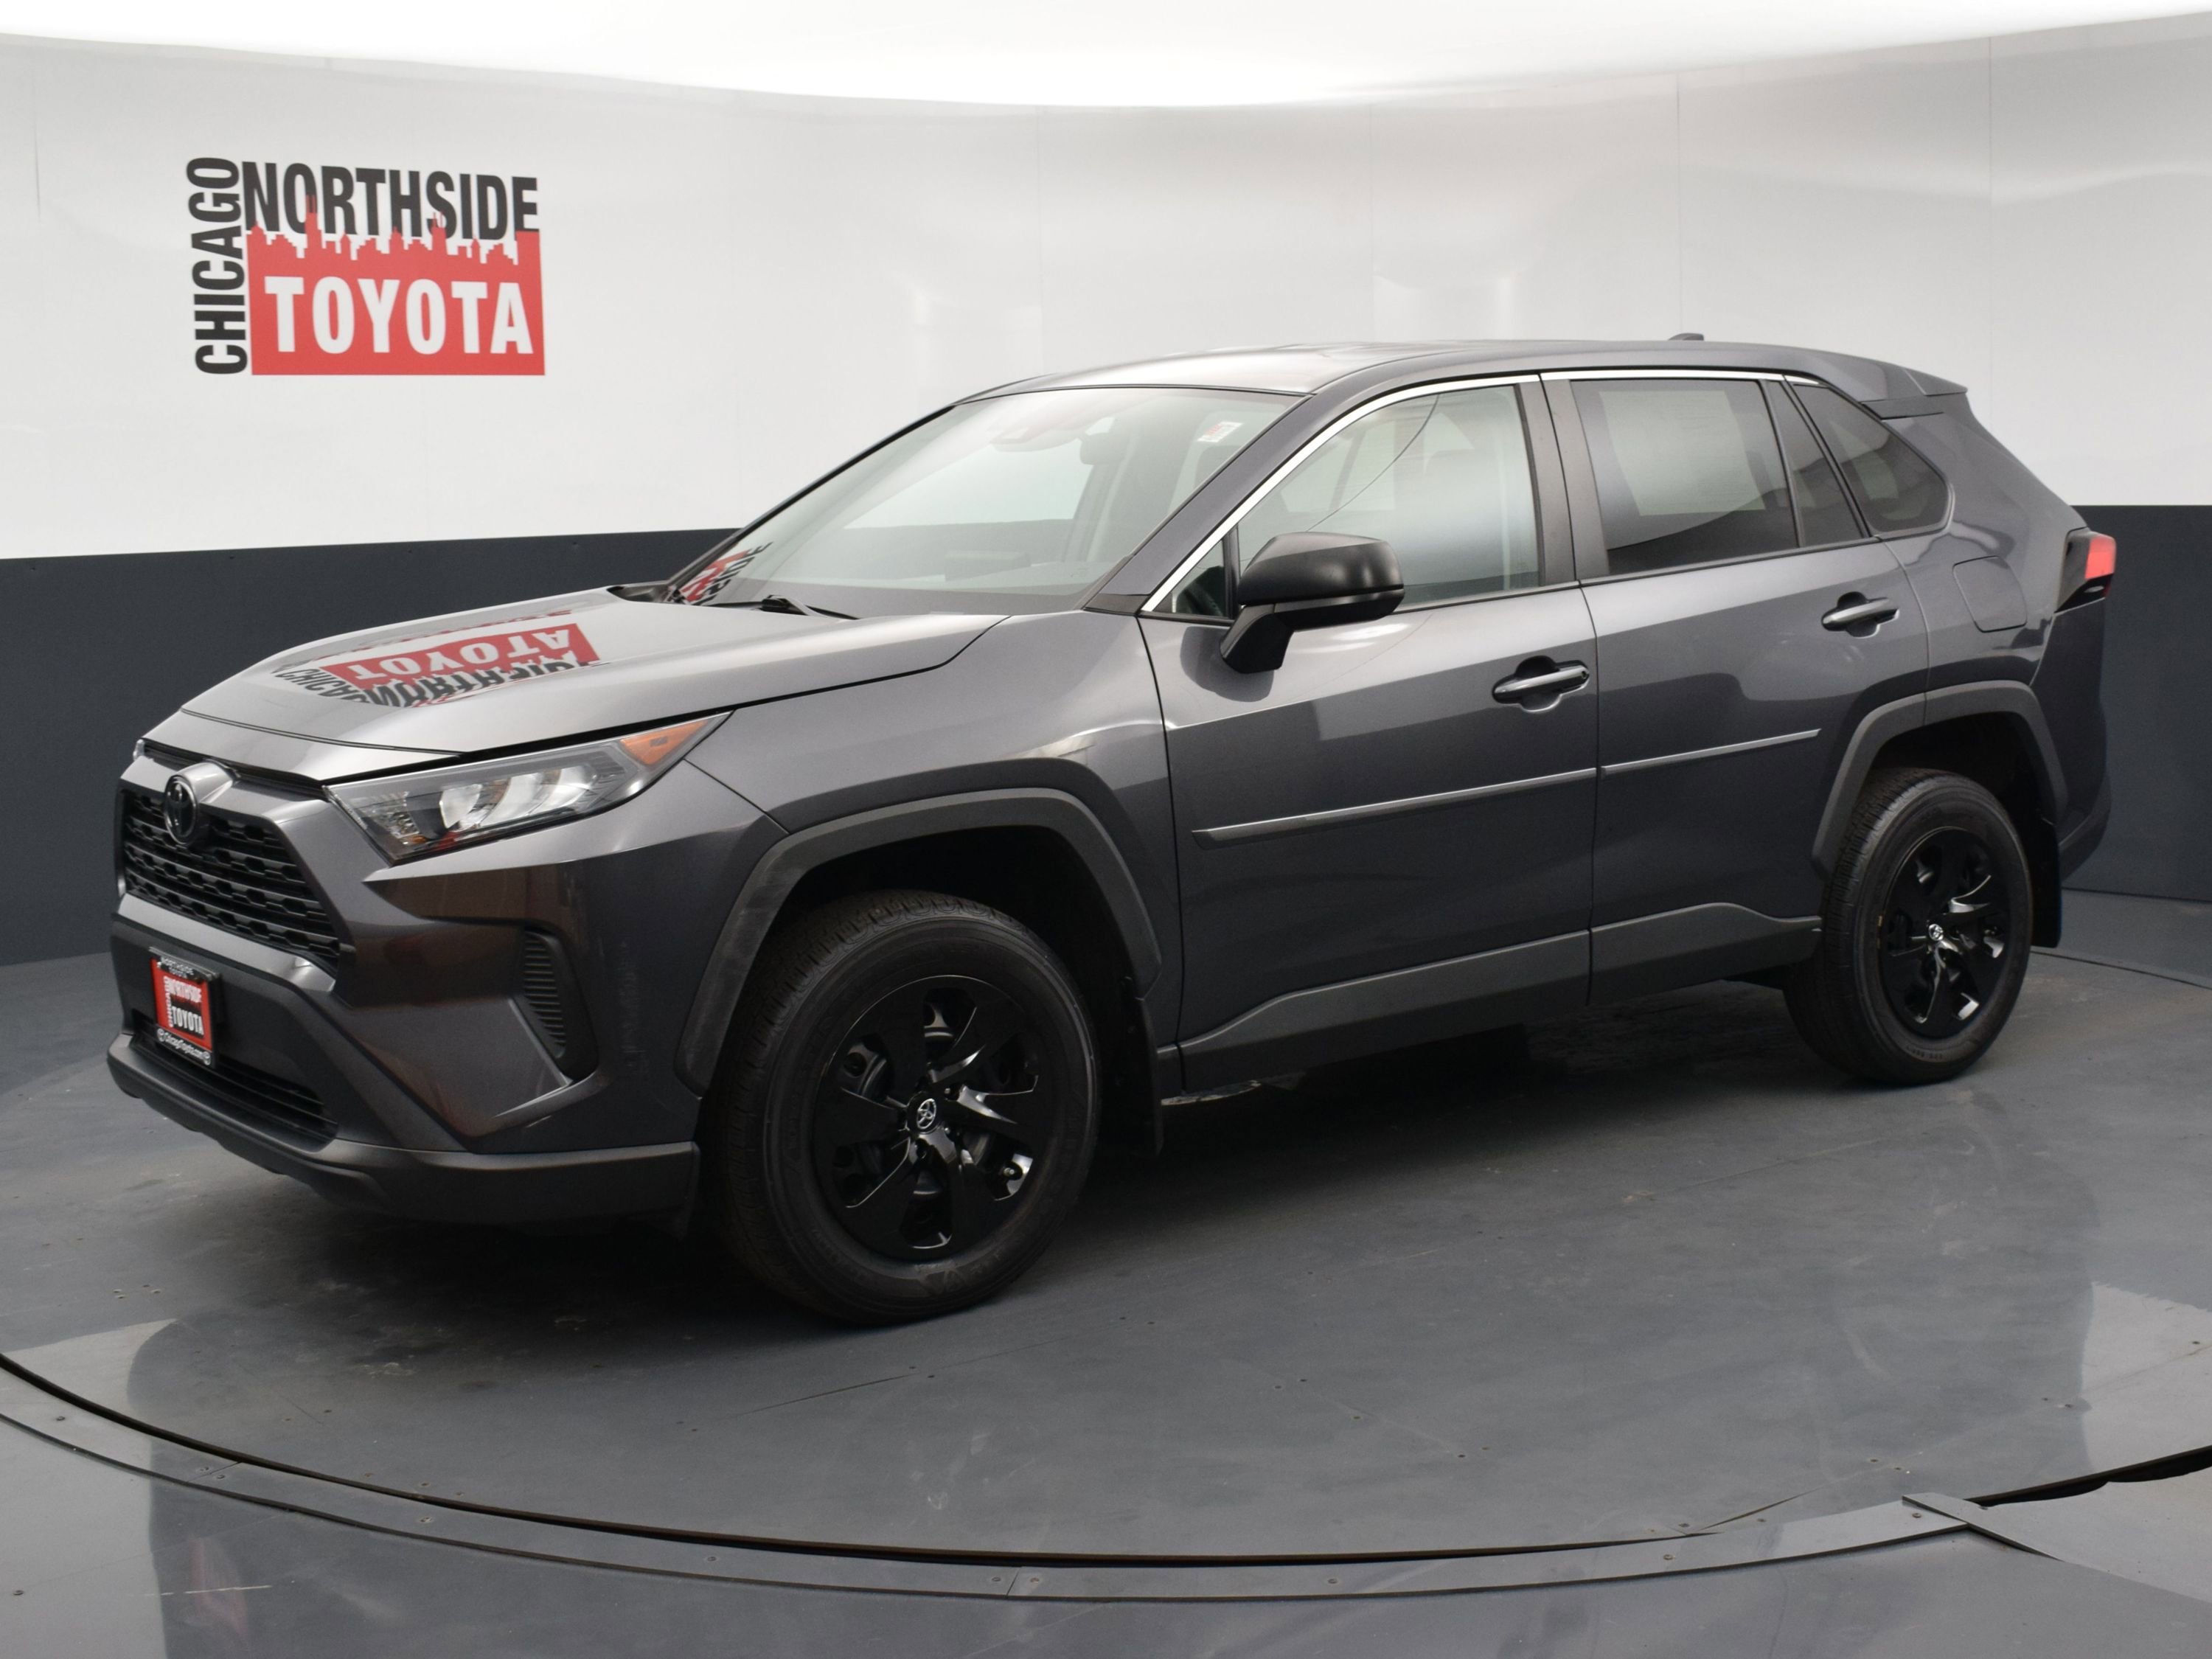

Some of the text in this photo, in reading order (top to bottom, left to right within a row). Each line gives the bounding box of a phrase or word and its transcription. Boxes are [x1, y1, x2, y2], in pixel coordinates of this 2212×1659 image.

[241, 161, 540, 240] NORTHSIDE
[187, 157, 248, 375] CHICAGO
[264, 276, 534, 355] TOYOTA
[171, 1006, 204, 1035] TOYOTA
